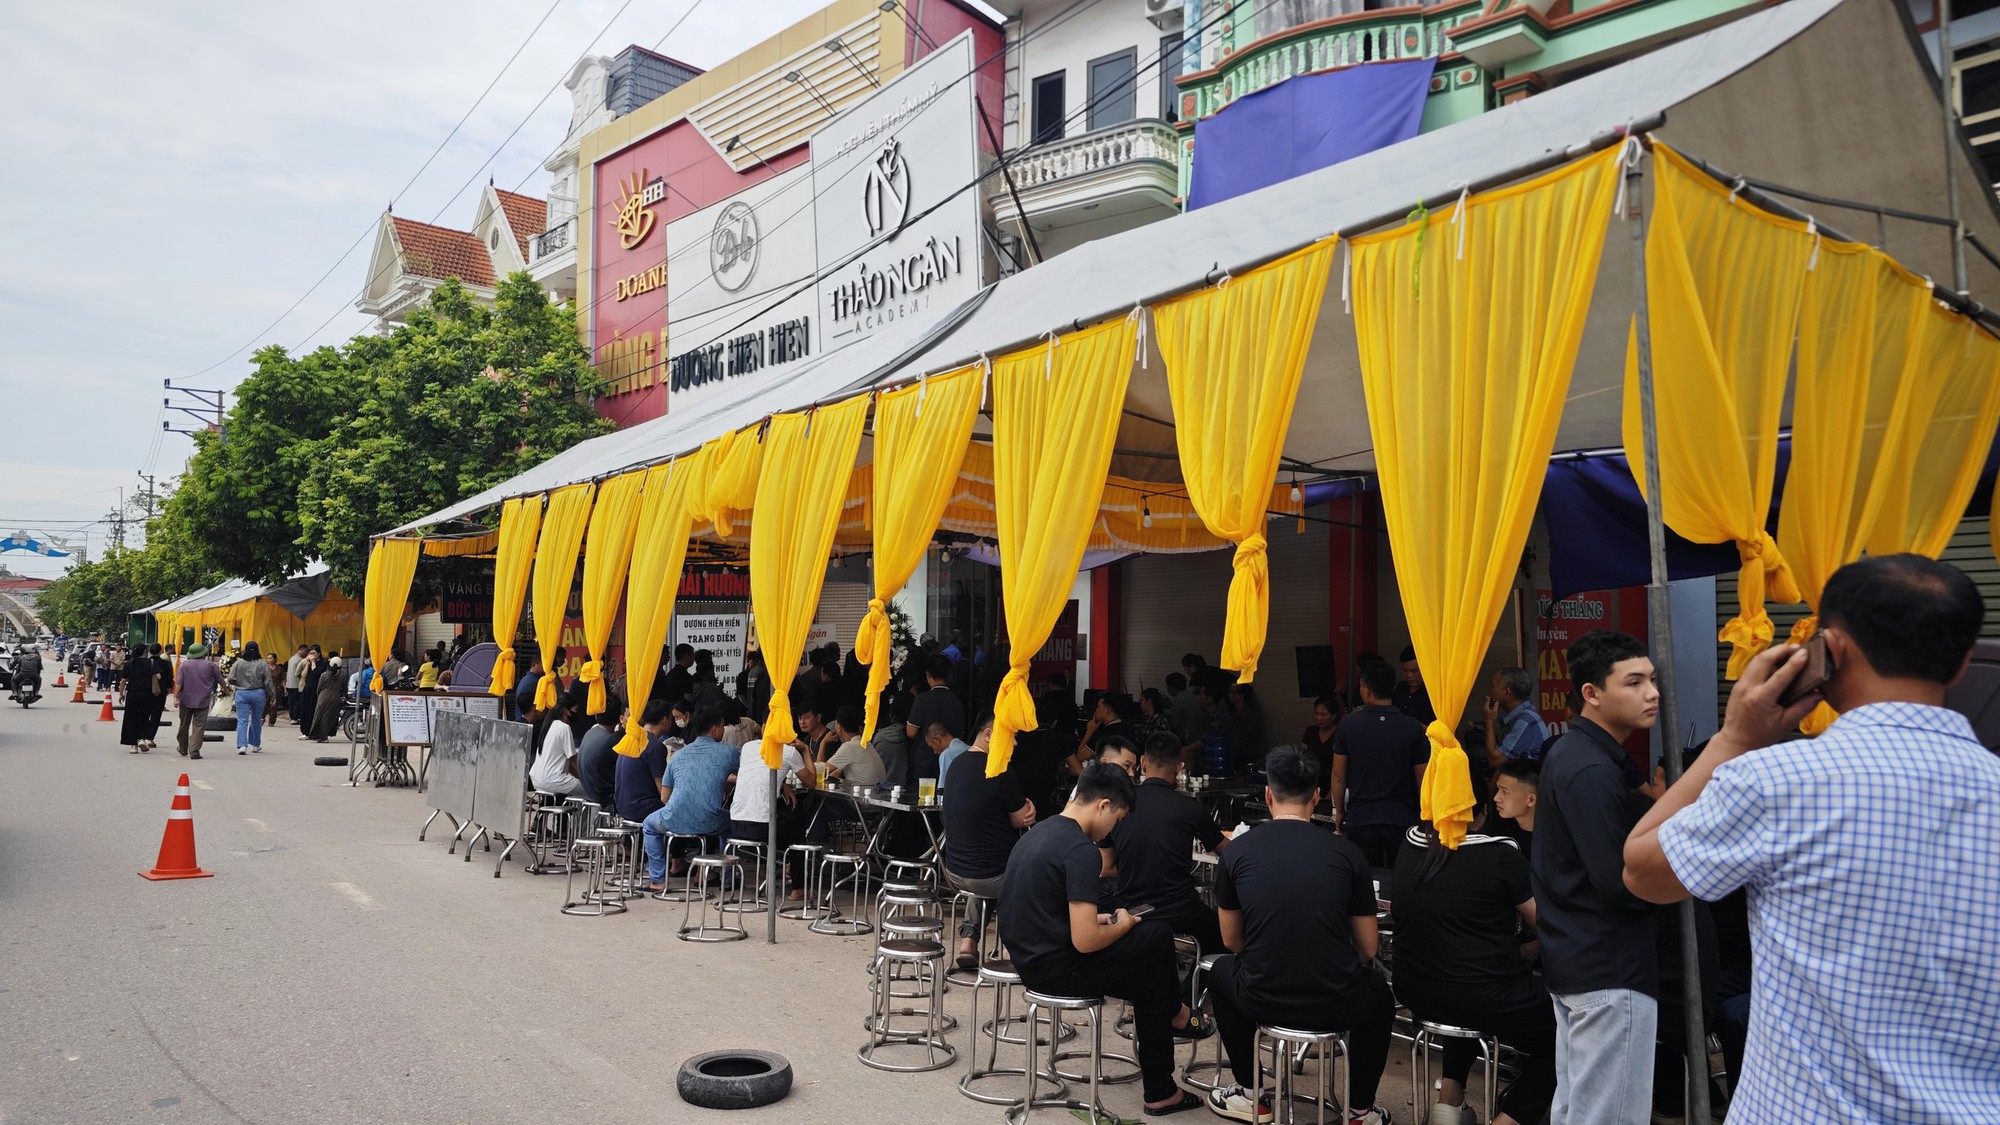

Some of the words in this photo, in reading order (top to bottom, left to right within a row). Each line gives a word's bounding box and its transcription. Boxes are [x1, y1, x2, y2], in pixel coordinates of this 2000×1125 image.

[643, 182, 665, 206] HH
[855, 295, 930, 333] ACADEMY
[448, 579, 482, 595] VÀNG
[687, 634, 715, 643] TRANG
[716, 630, 736, 643] ĐIỂM
